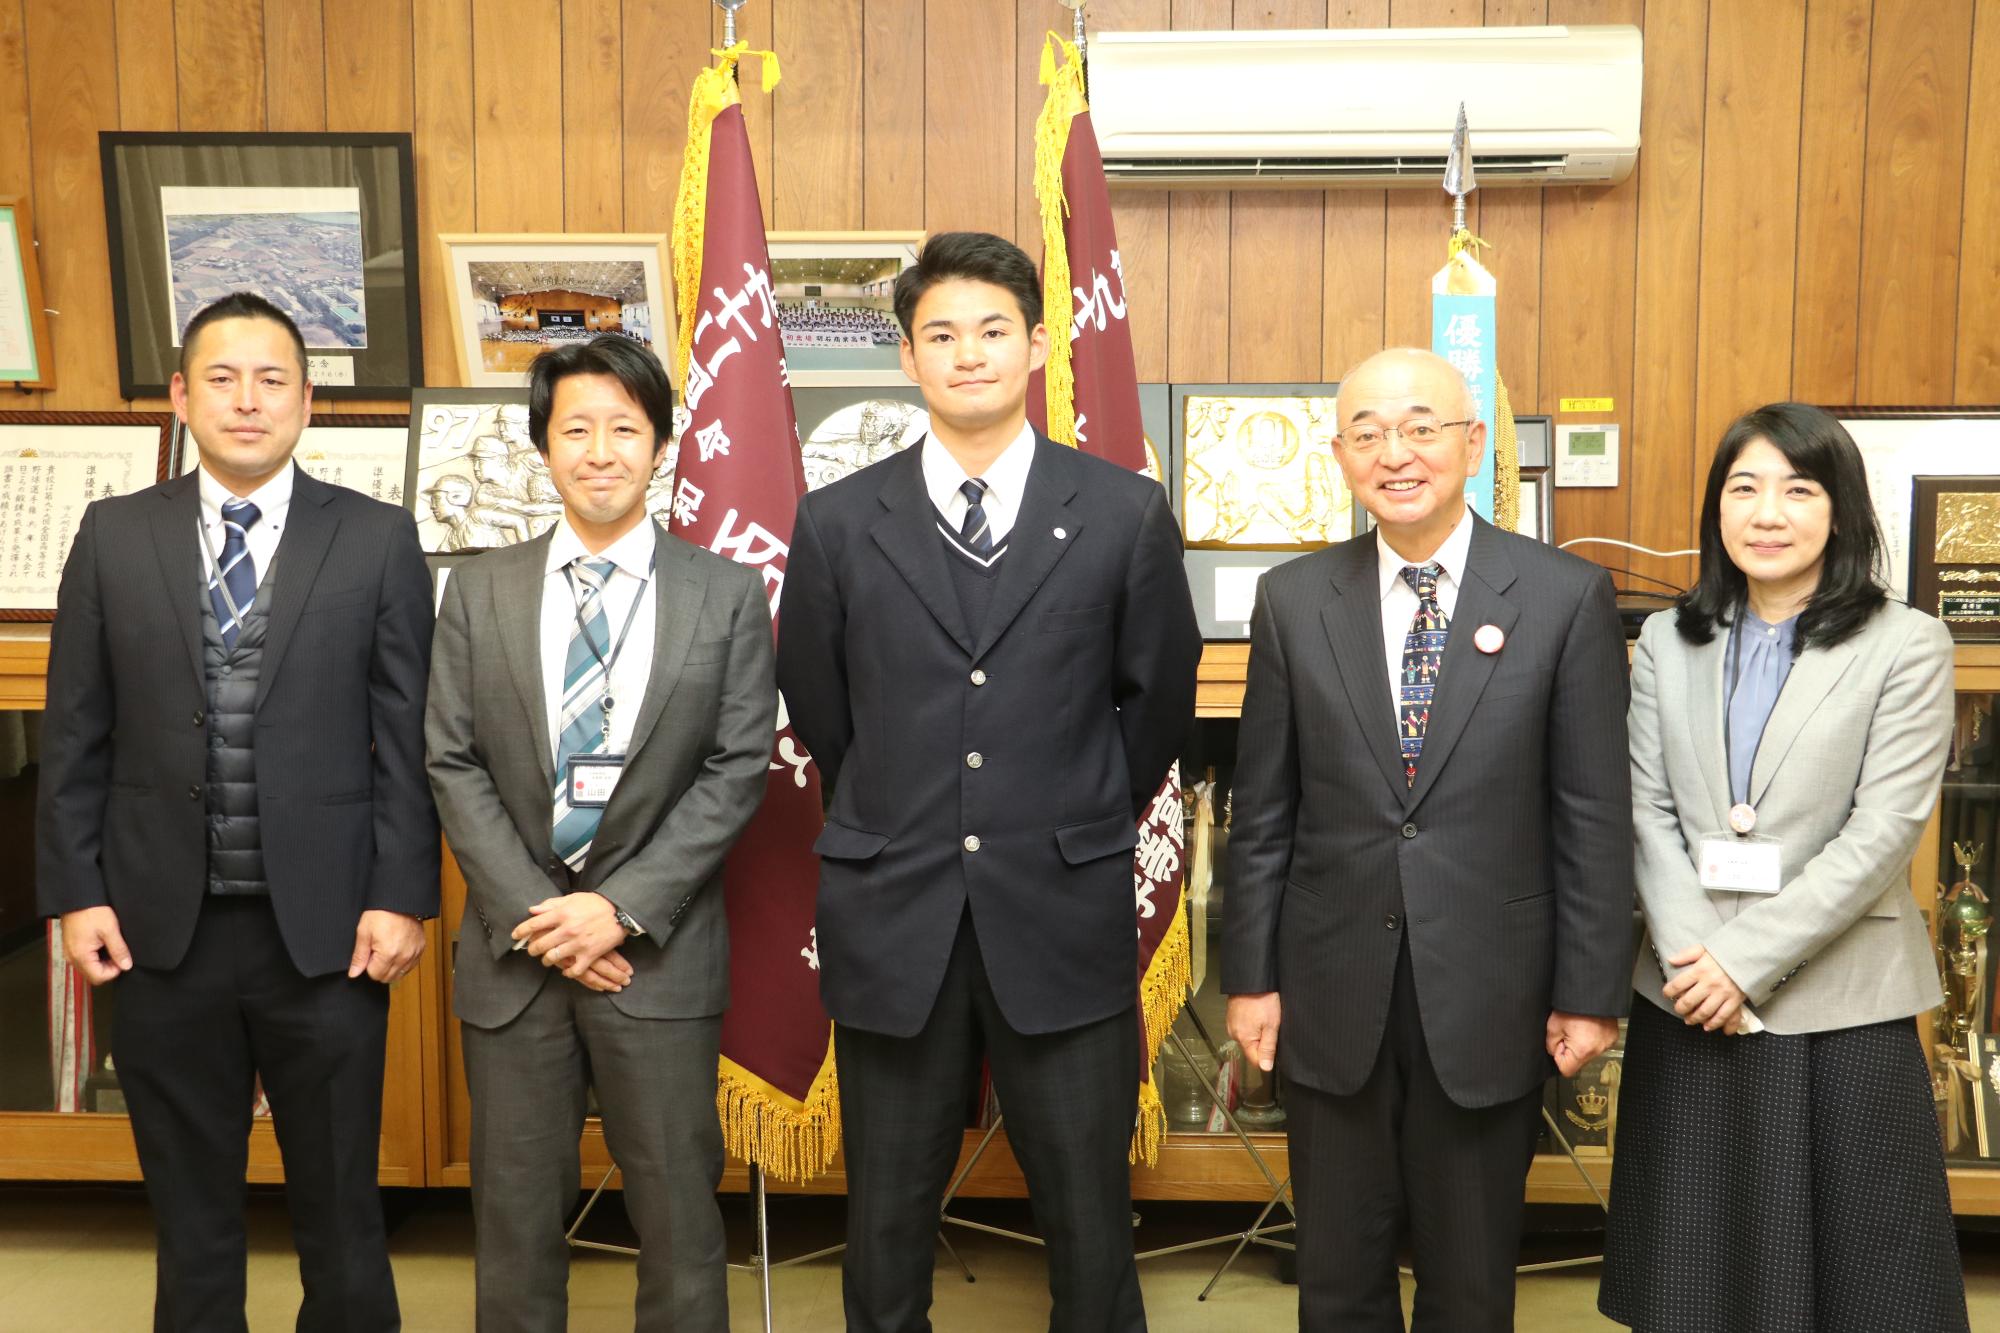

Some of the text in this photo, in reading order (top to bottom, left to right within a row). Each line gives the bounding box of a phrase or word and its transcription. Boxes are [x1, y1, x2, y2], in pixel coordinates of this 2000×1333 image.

[1443, 313, 1483, 382] 優勝
[426, 407, 480, 449] 97
[84, 464, 97, 499] 準優勝
[388, 483, 402, 501] 表
